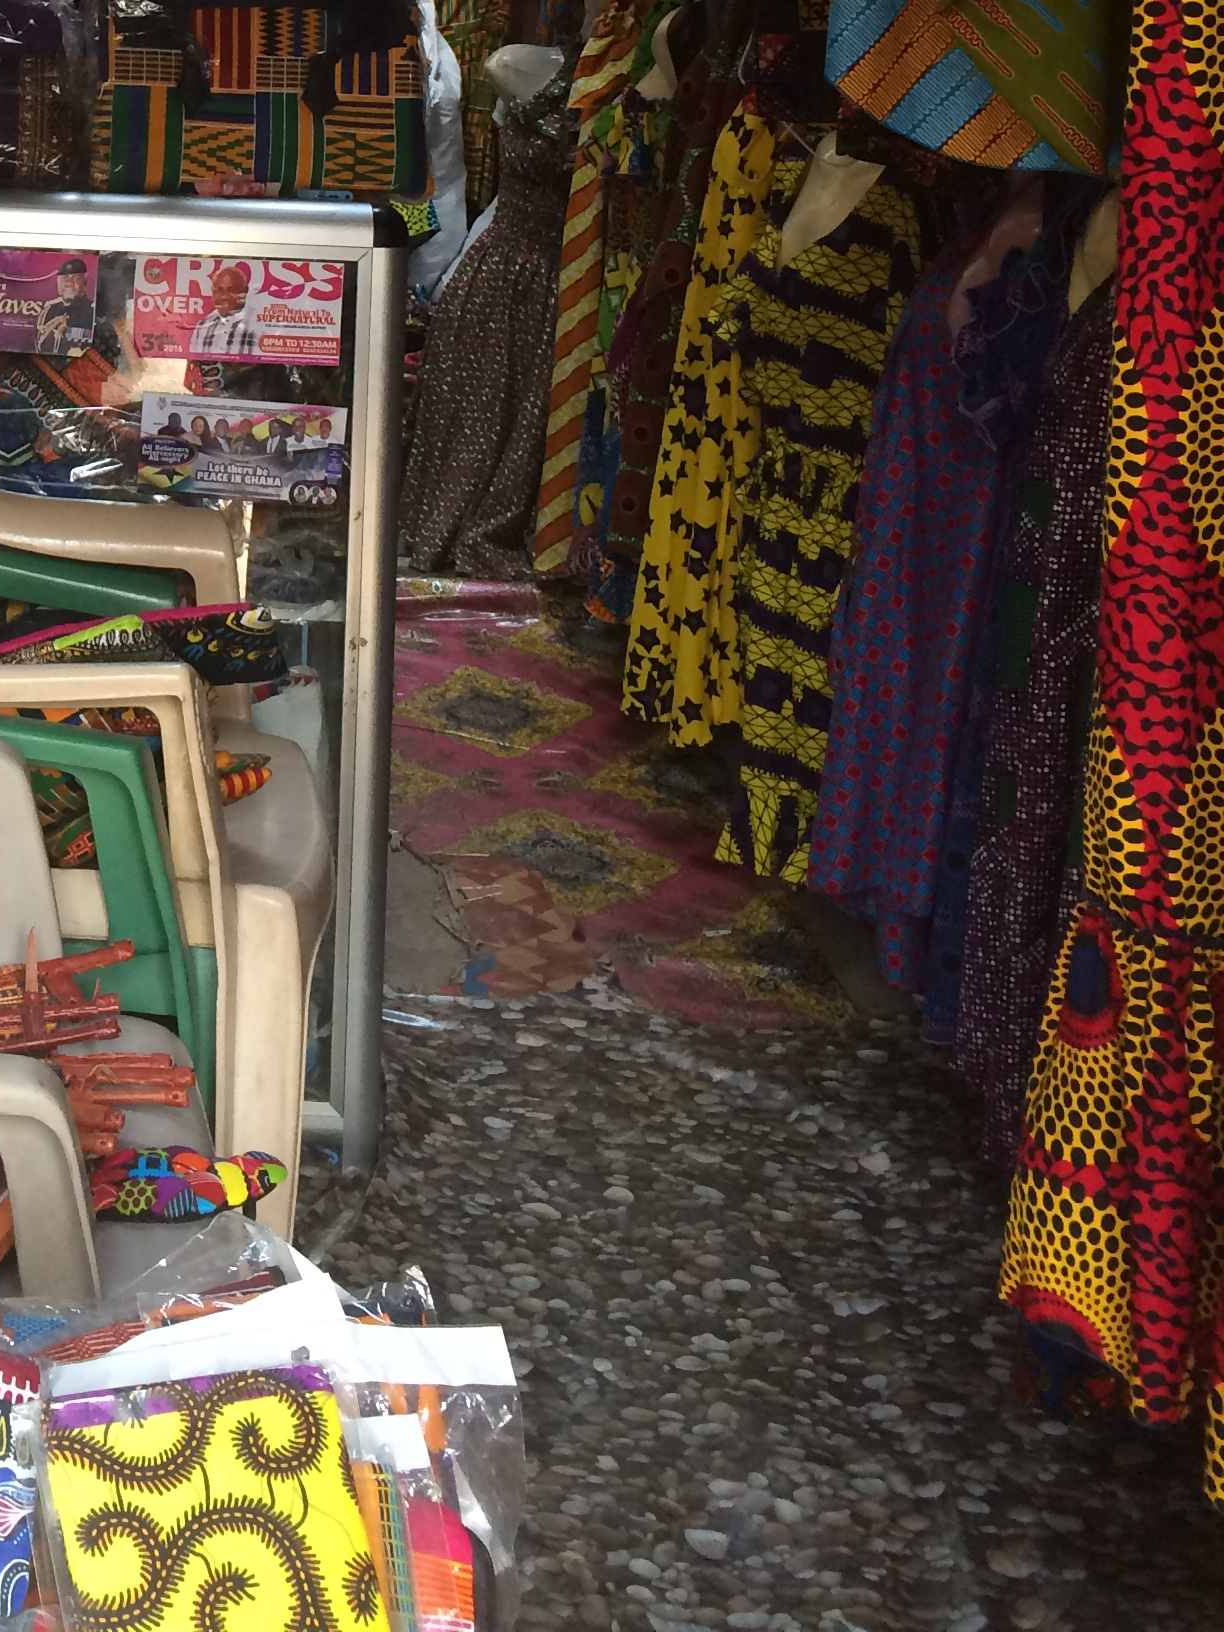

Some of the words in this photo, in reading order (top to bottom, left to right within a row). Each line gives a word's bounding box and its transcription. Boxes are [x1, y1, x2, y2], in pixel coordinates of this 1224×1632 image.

[137, 296, 204, 315] OVER
[256, 313, 336, 326] SUPERNATURAL
[208, 462, 225, 473] Let
[227, 464, 254, 475] there
[196, 471, 229, 483] PEACE
[230, 474, 242, 484] IN
[244, 475, 282, 487] GHANA
